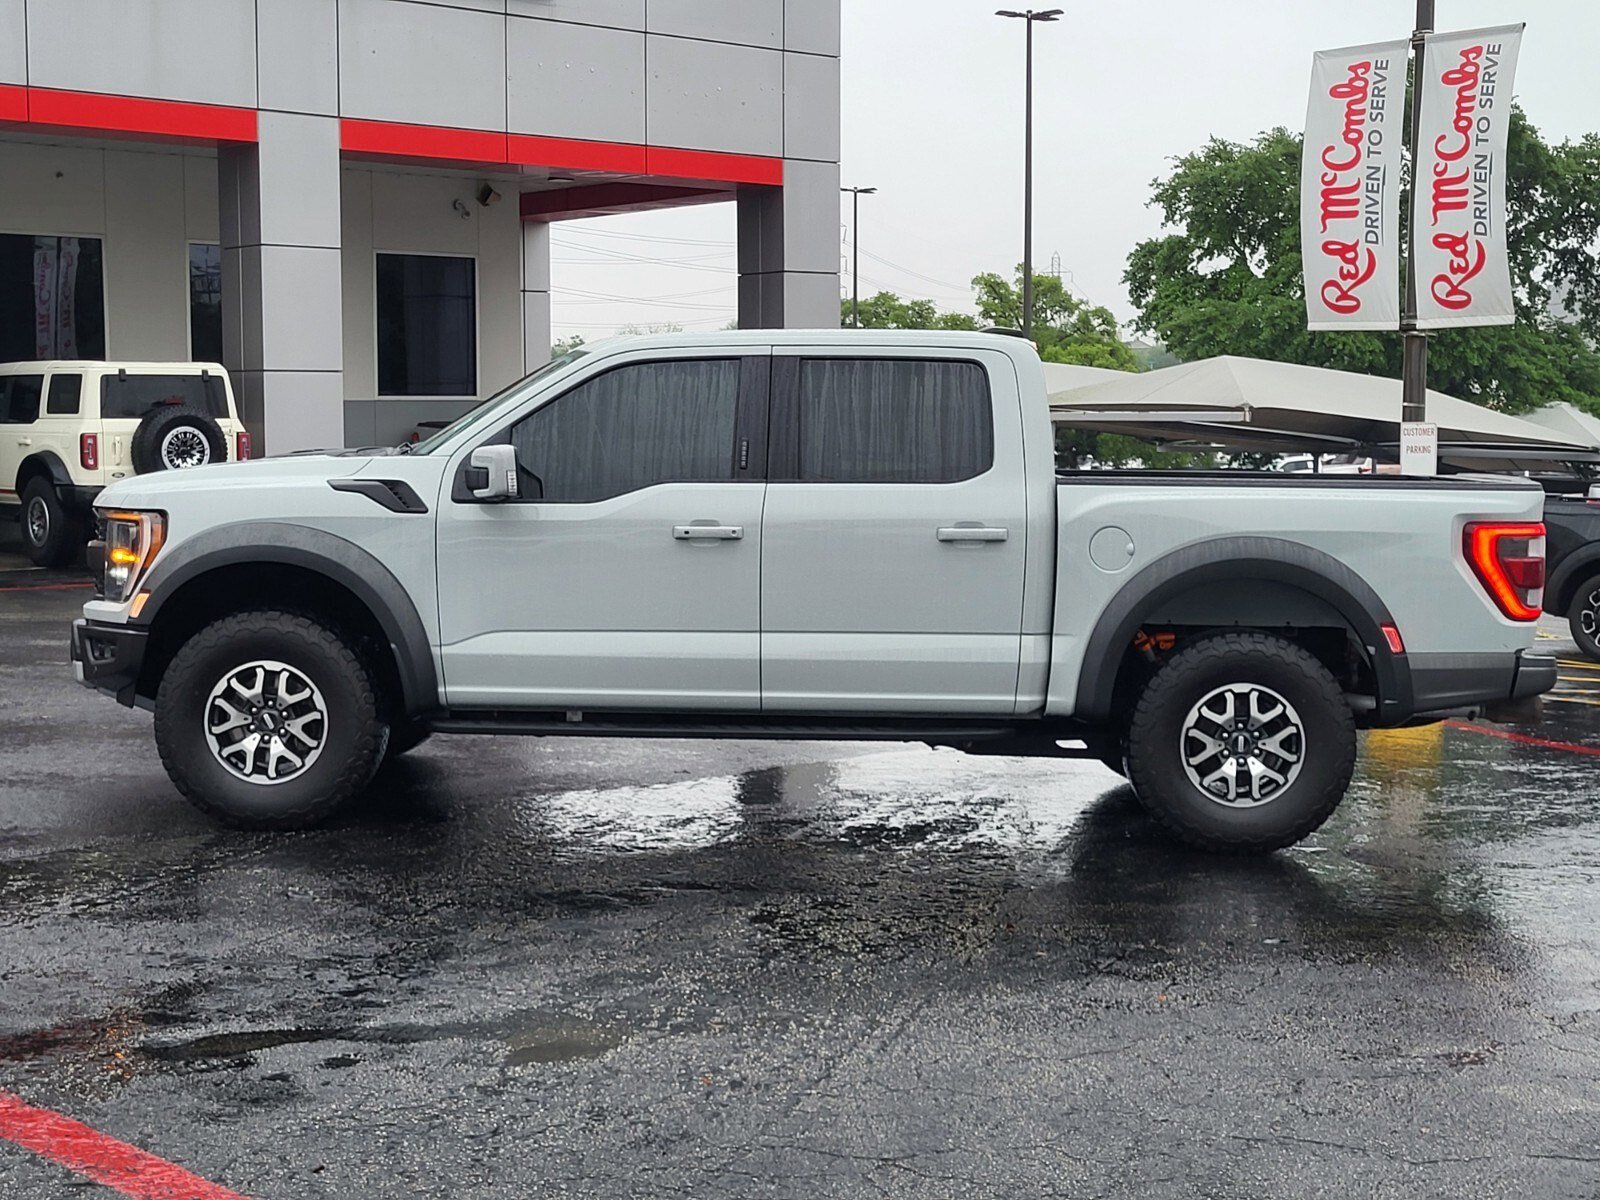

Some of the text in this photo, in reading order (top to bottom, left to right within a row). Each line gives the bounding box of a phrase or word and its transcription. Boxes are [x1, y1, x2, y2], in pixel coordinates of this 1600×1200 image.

[1321, 61, 1375, 314] Red McCombs
[1365, 59, 1389, 245] DRIVEN TO SERVE
[1432, 46, 1486, 310] Red McCombs
[1474, 44, 1501, 237] DRIVEN TO SERVE
[1403, 428, 1434, 436] CUSTOMER
[1406, 445, 1431, 454] PARKING
